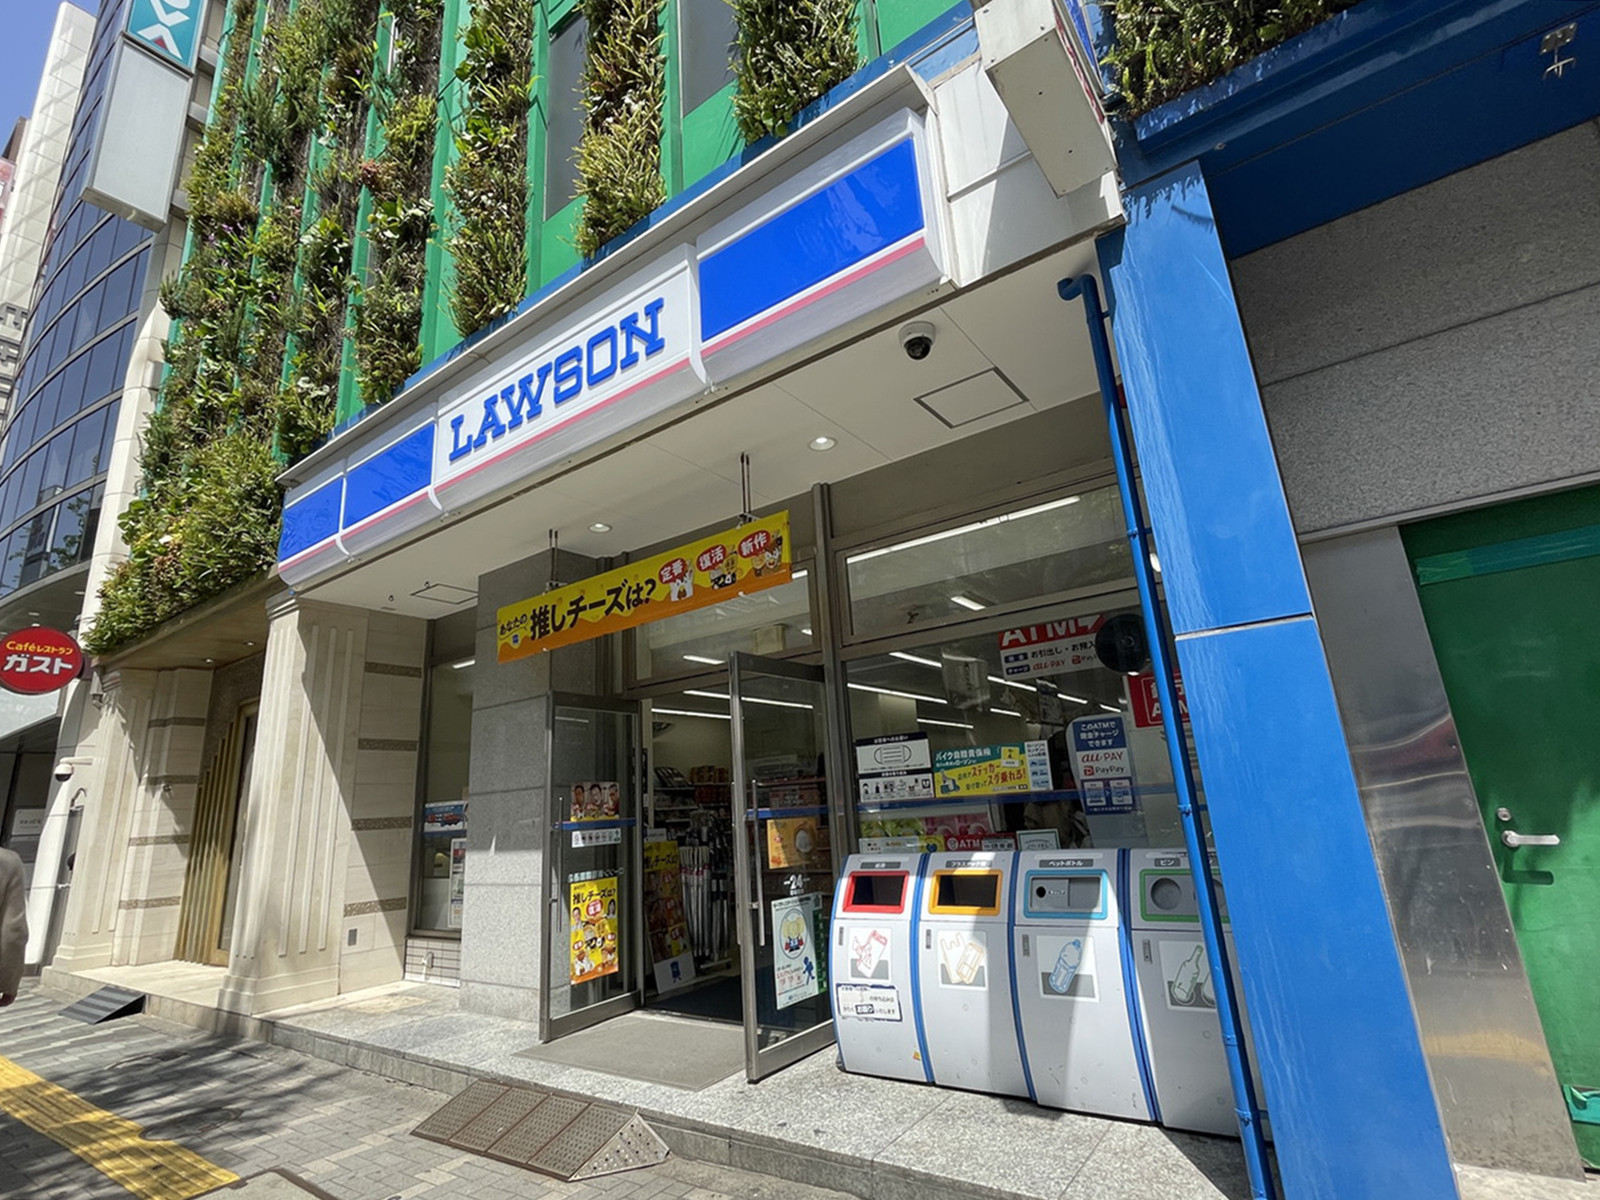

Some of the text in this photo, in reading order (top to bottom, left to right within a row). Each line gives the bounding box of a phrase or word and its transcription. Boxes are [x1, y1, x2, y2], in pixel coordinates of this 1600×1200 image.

[449, 297, 665, 464] LAWSON
[530, 578, 657, 641] 推しチーズは?
[3, 653, 73, 675] ガスト
[1082, 751, 1123, 763] au PAY
[1095, 765, 1125, 774] PayPay
[959, 838, 981, 849] ATM
[1048, 859, 1085, 867] ペットボトル
